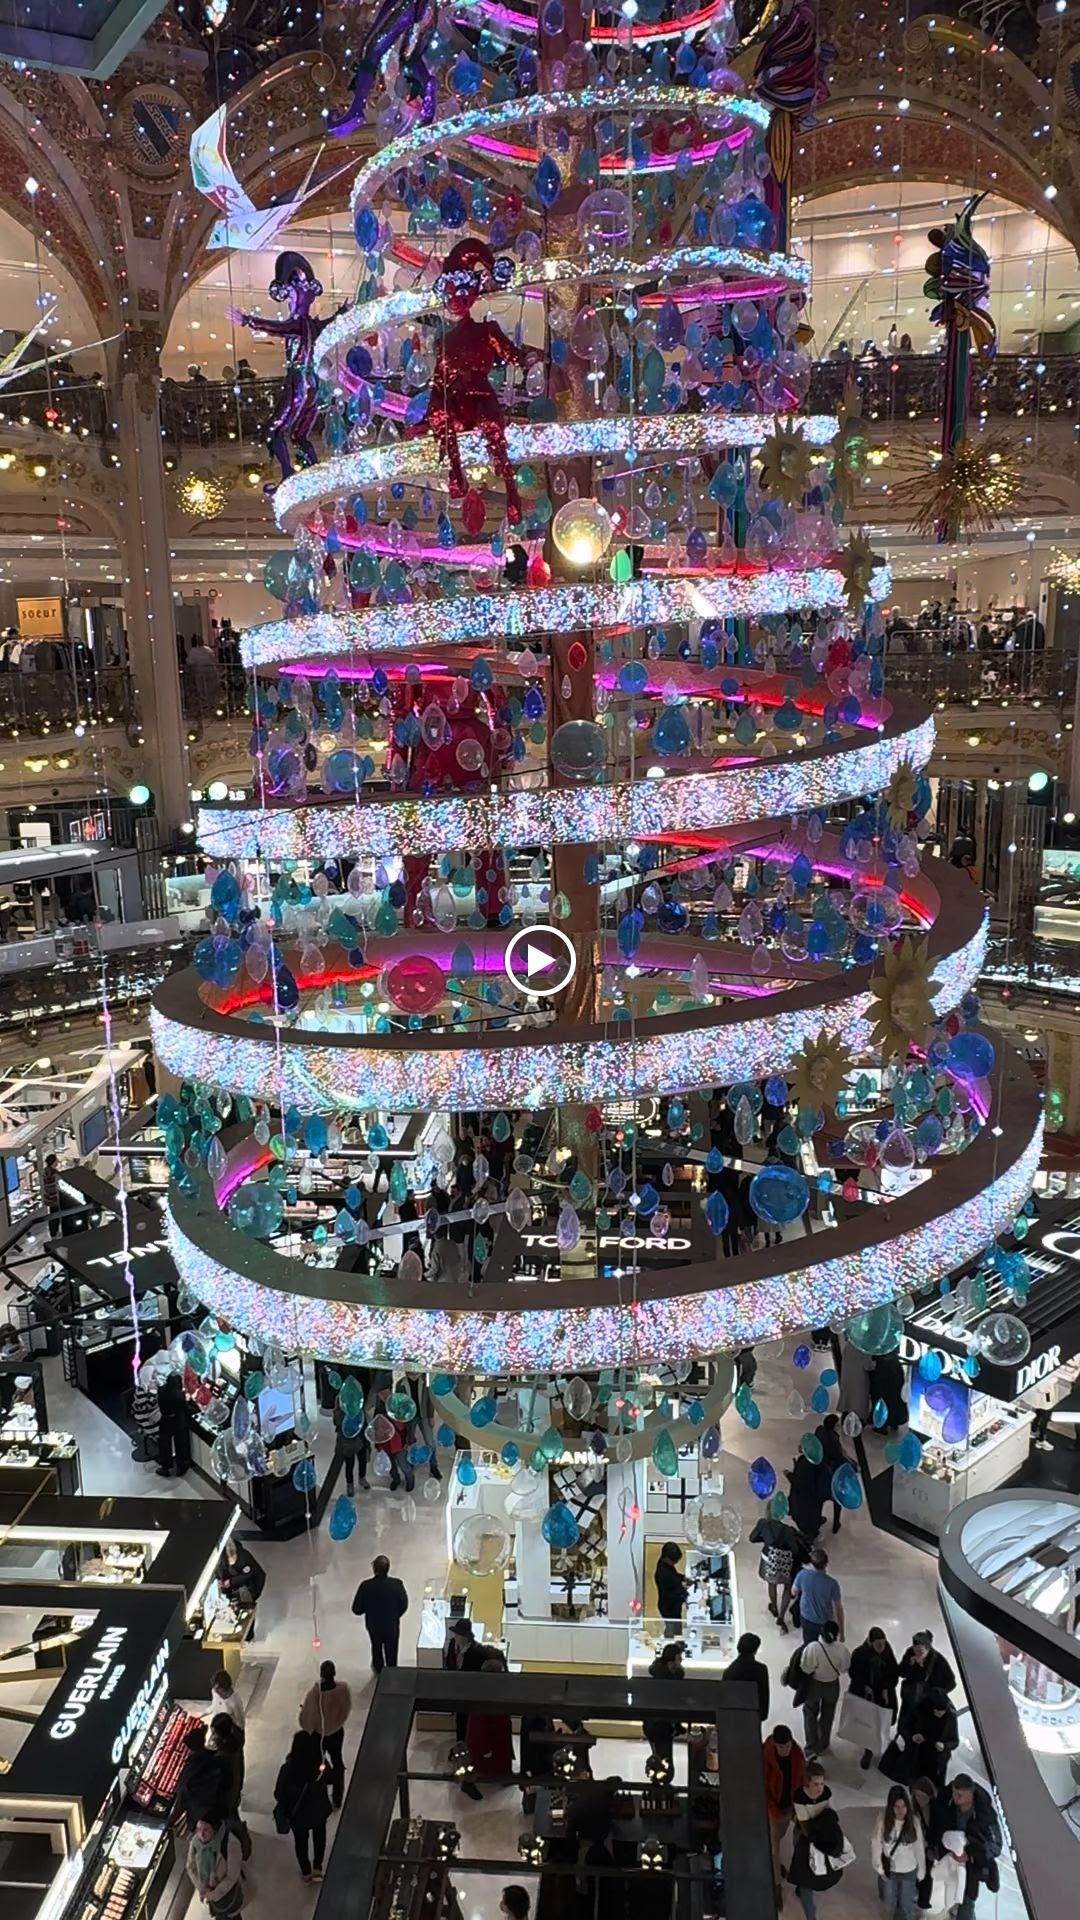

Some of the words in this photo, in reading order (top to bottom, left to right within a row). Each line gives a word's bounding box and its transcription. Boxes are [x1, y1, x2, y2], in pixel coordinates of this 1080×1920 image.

[599, 1236, 692, 1250] FORD
[1015, 1345, 1062, 1395] DIOR
[50, 1626, 129, 1740] GUERLAIN
[99, 1664, 126, 1700] PARIS
[111, 1638, 170, 1764] GUERLAIN
